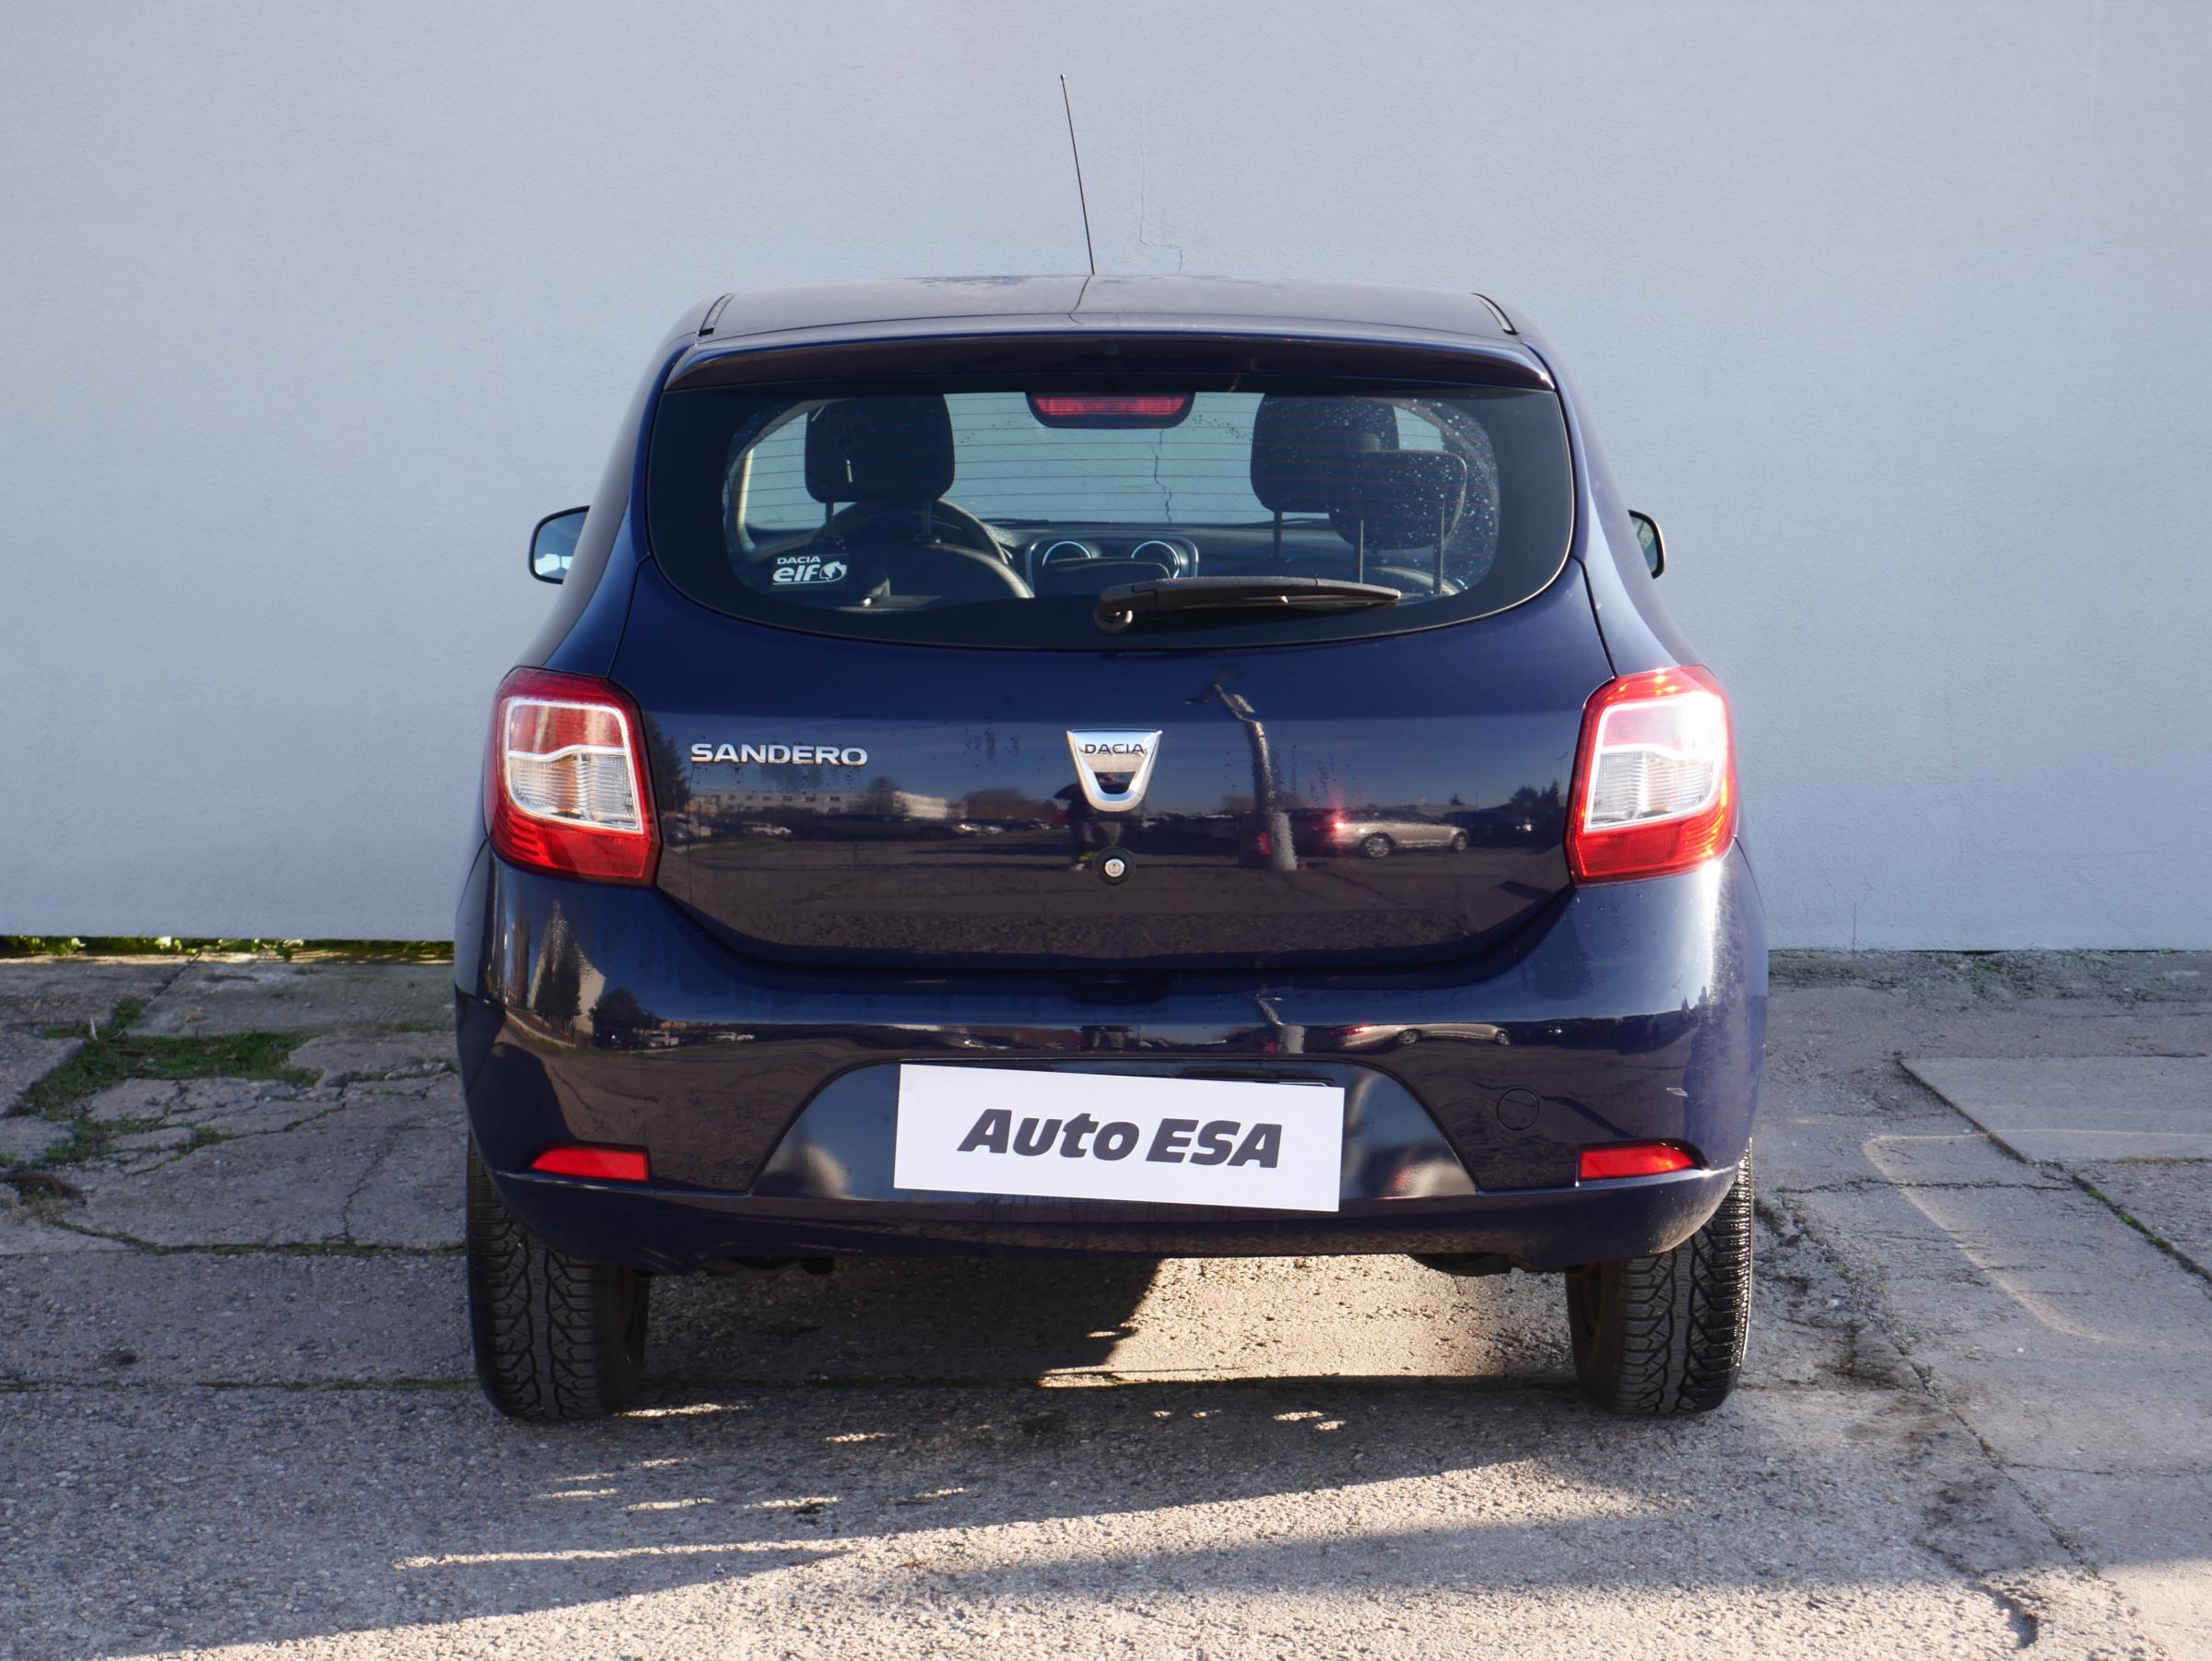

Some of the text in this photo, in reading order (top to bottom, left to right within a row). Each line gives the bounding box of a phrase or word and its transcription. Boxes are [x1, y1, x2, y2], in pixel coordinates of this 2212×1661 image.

[777, 555, 821, 565] DACIA
[772, 564, 821, 583] elf
[690, 743, 868, 767] SANDERO
[1084, 744, 1145, 755] DACIA
[956, 1107, 1283, 1169] Auto ESA
